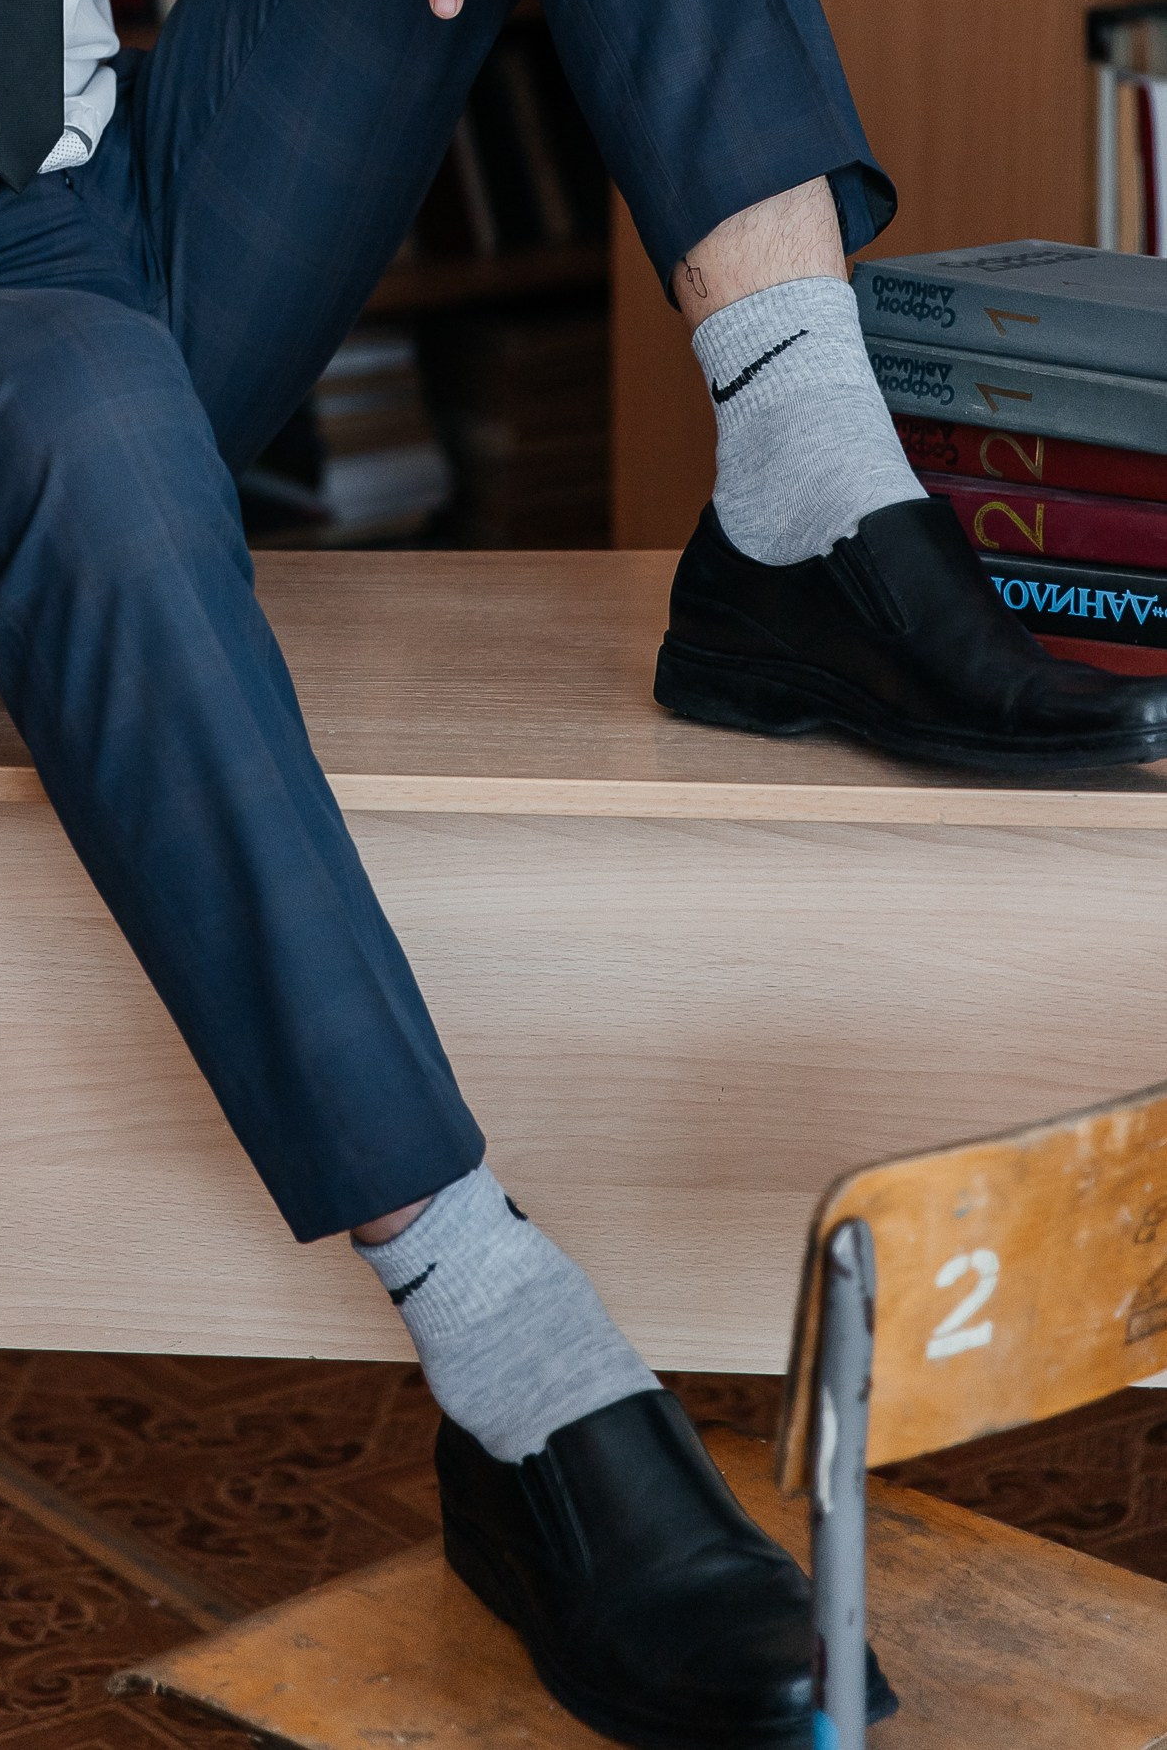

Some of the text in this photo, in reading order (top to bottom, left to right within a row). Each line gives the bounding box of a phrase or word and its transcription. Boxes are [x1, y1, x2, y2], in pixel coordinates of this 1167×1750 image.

[872, 274, 956, 305] Данилов
[876, 296, 956, 329] Софрон
[984, 307, 1041, 337] 1
[975, 382, 1033, 414] 1
[980, 431, 1045, 481] 2
[974, 501, 1045, 553] 2
[926, 1247, 1001, 1360] 2
